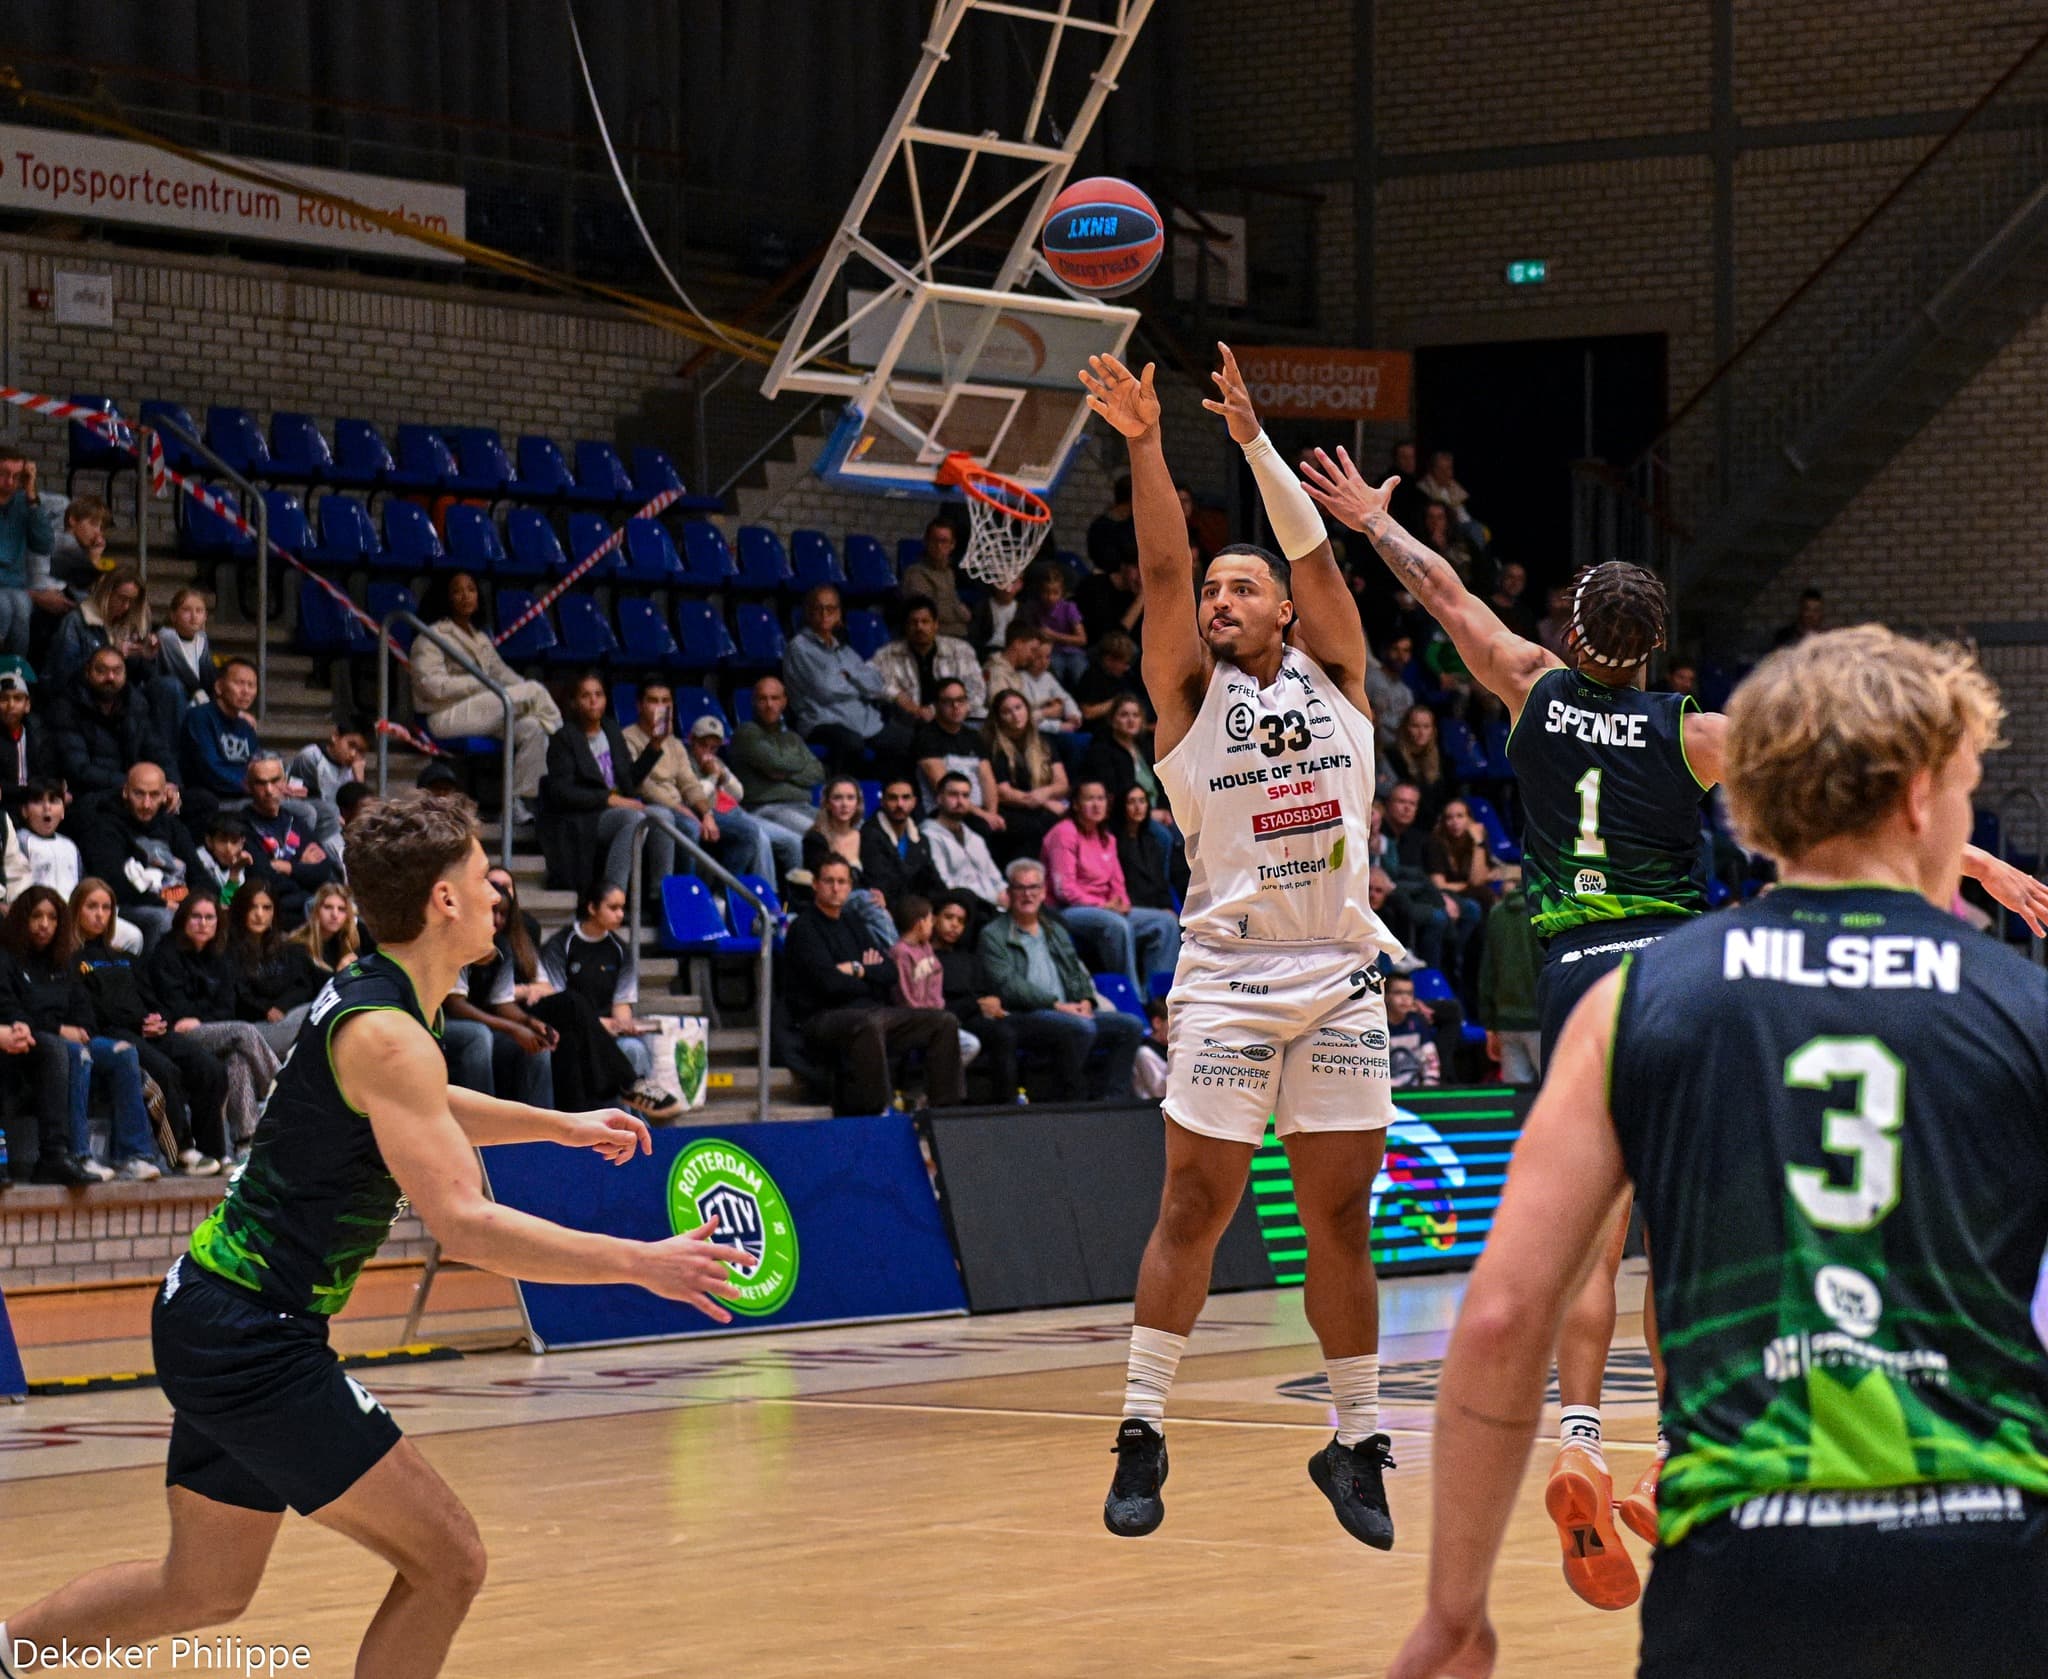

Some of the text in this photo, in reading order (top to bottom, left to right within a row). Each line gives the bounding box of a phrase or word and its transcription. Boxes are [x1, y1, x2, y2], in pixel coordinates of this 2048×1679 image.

[16, 152, 281, 222] Topsportcentrum
[1259, 709, 1313, 758] 33
[1545, 699, 1649, 749] SPENCE
[1209, 769, 1268, 792] HOUSE
[1272, 765, 1292, 780] OF
[1573, 767, 1608, 858] 1
[1579, 873, 1600, 883] SUN
[1582, 882, 1602, 892] DAY
[1723, 926, 1961, 995] NILSEN
[1196, 1051, 1240, 1059] JAGUAR
[1312, 1041, 1359, 1049] JAGUAR
[1191, 1075, 1269, 1091] KORTRIJK
[1193, 1064, 1271, 1080] DEJONCKHEERE
[1783, 1034, 1907, 1234] 3
[678, 1151, 763, 1198] ROTTERDAM
[704, 1192, 756, 1235] CITY
